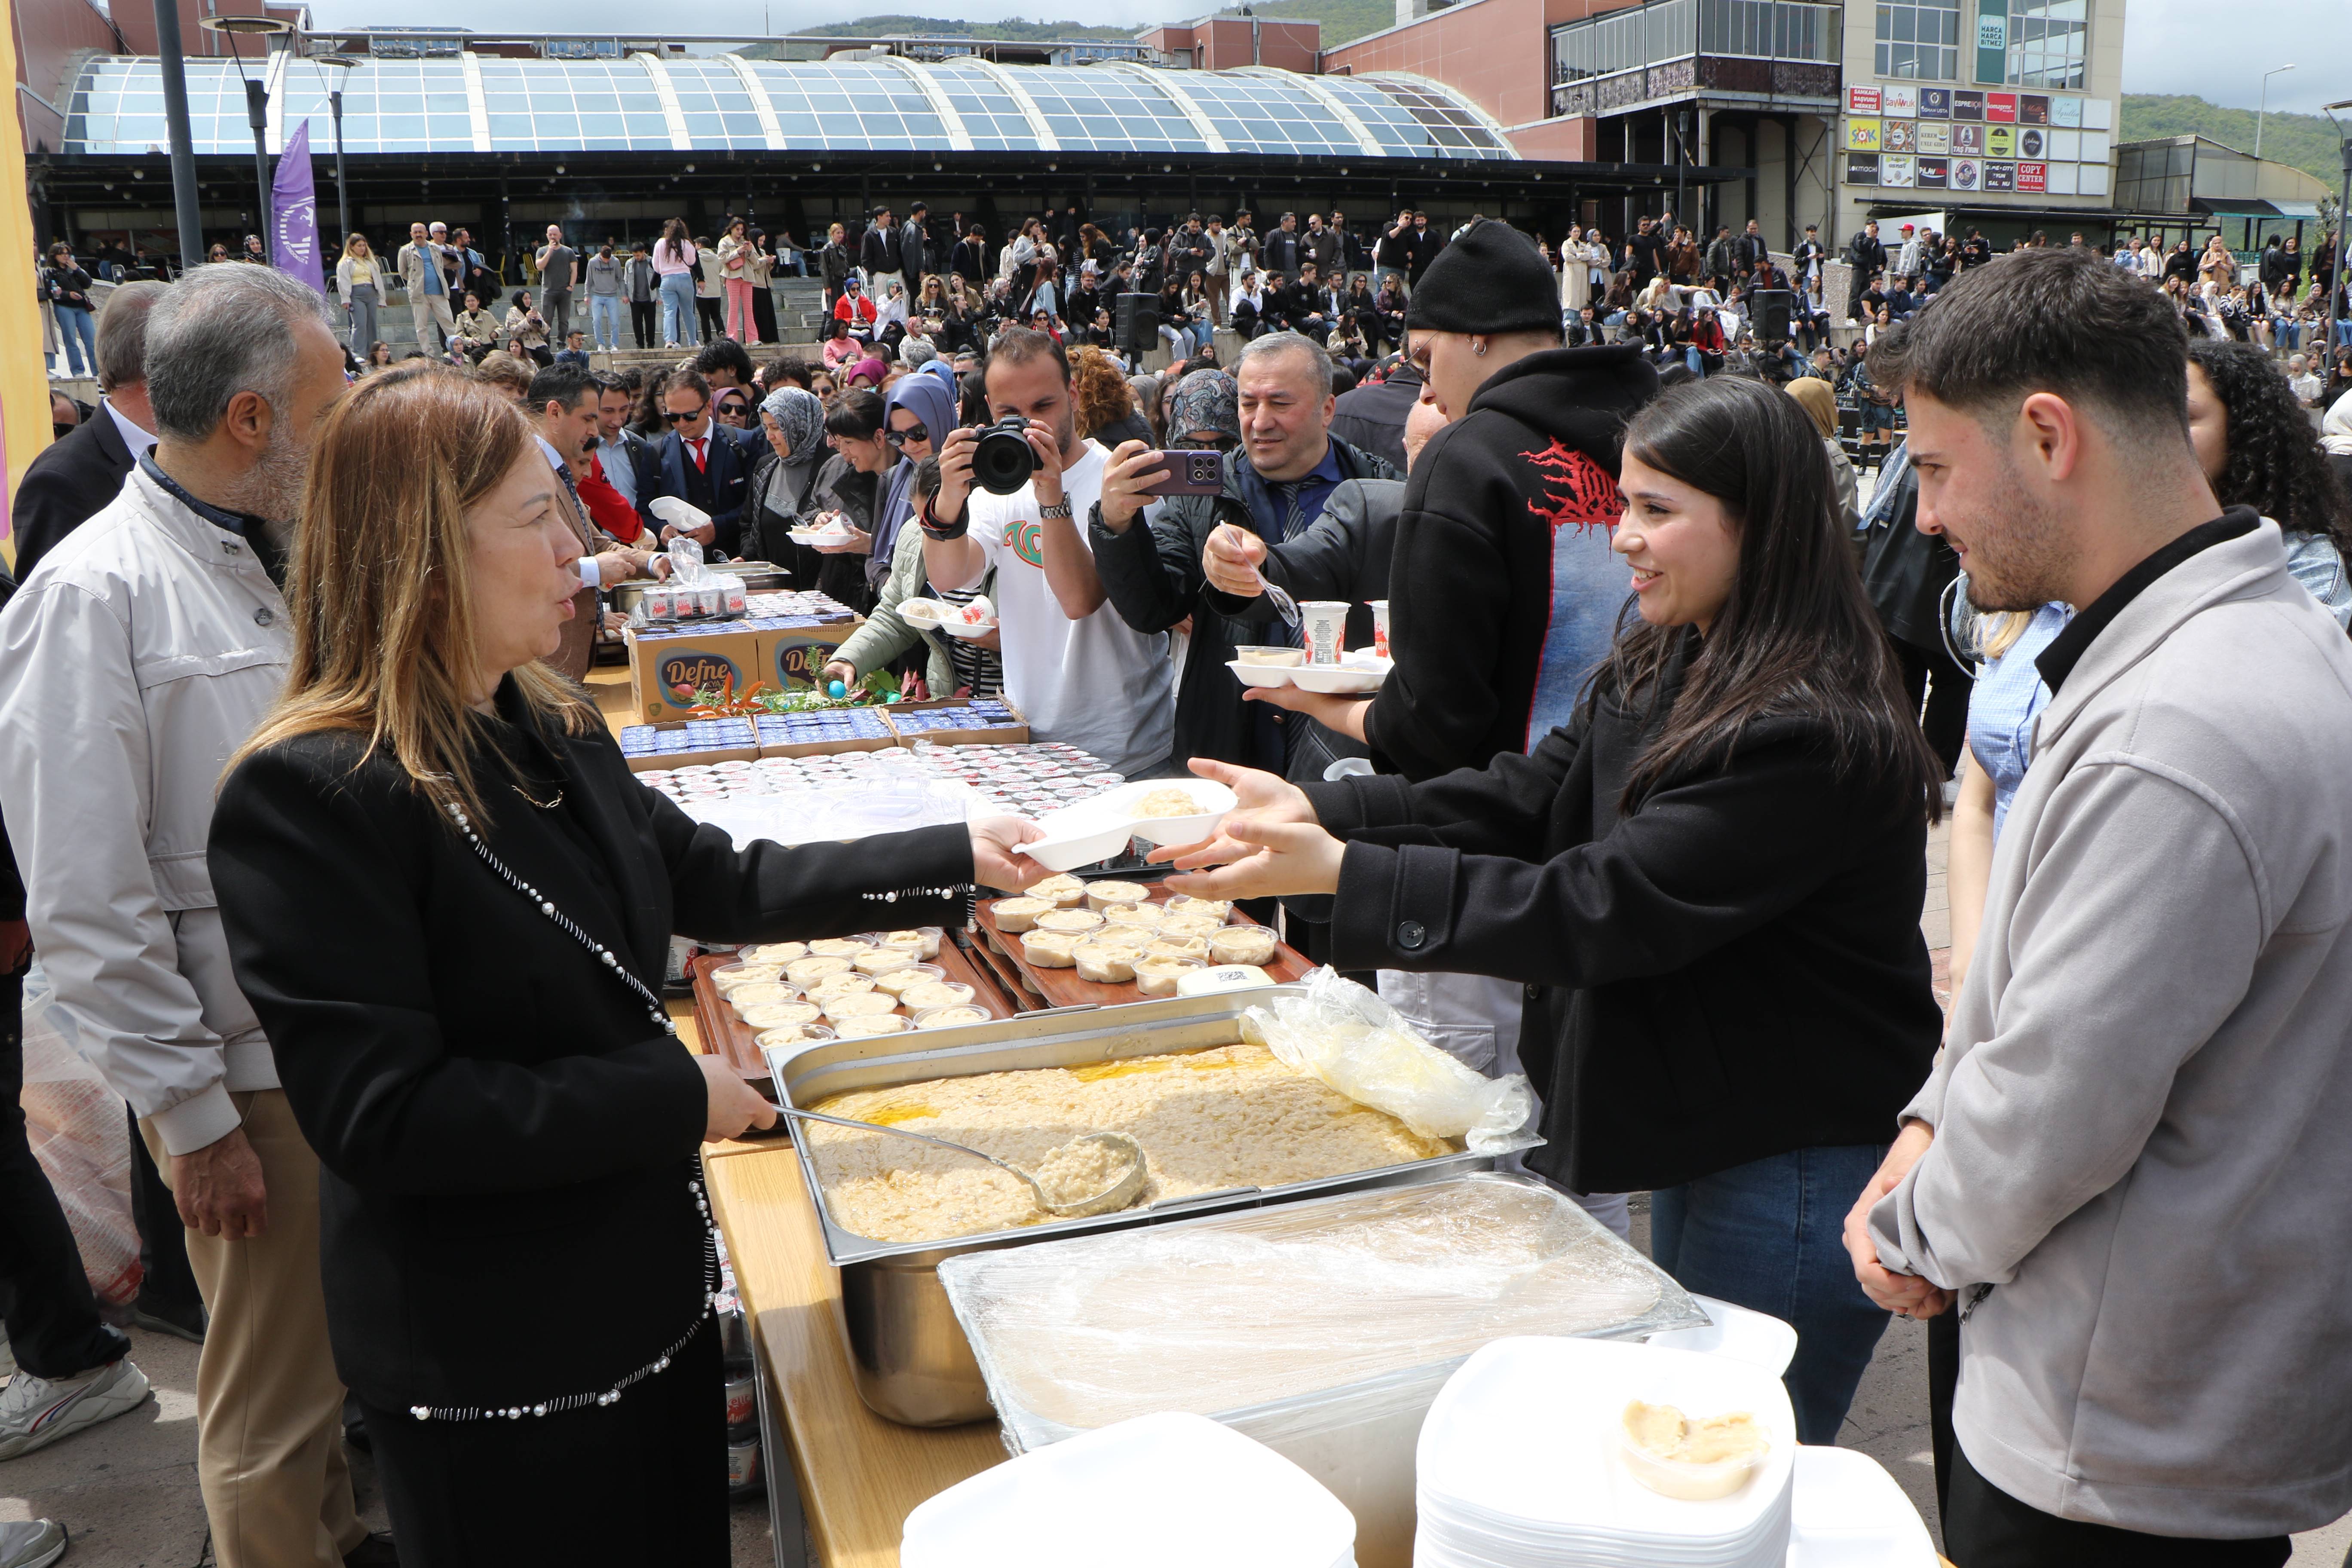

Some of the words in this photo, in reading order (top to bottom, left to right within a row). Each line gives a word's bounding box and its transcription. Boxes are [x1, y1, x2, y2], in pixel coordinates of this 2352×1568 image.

[1987, 102, 2012, 111] komagene
[1852, 128, 1877, 145] ŞOK
[2021, 165, 2042, 174] COPY
[2018, 175, 2043, 183] CENTER
[285, 245, 305, 263] ONDOKUZ
[667, 659, 728, 687] Defne
[701, 680, 725, 688] AKYAZ
